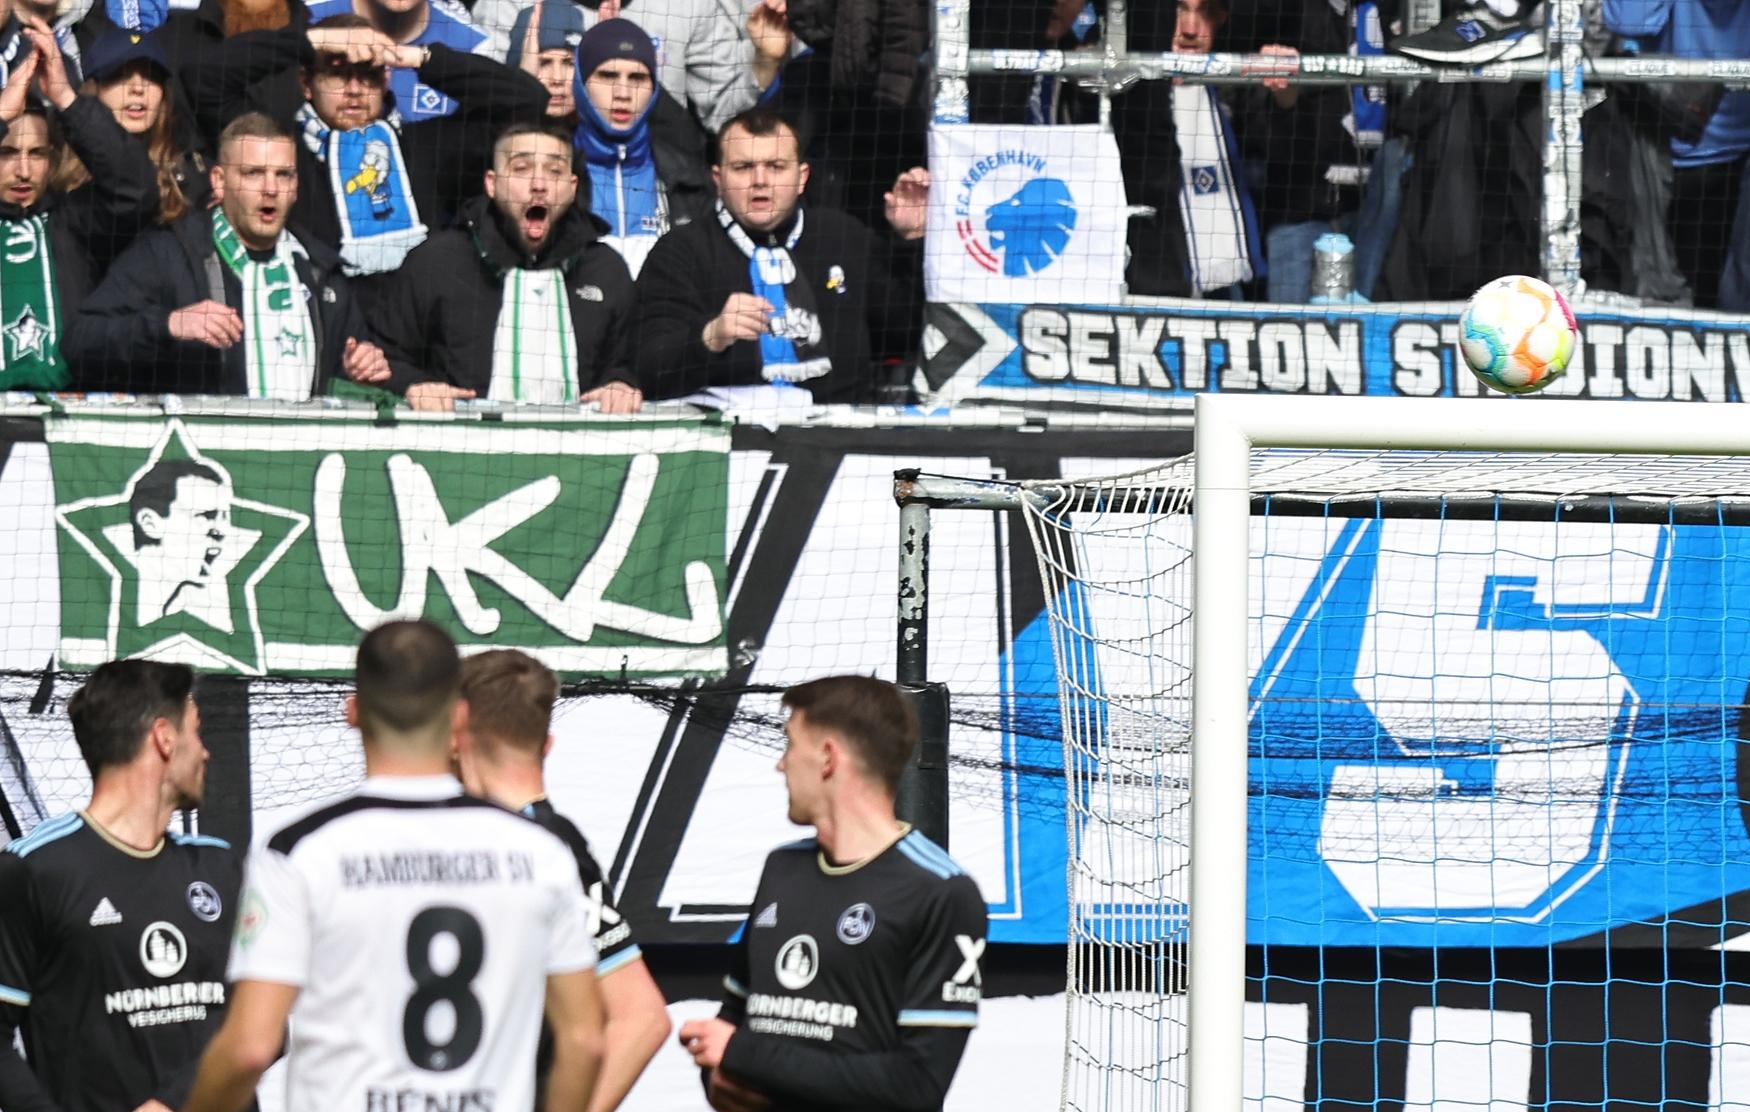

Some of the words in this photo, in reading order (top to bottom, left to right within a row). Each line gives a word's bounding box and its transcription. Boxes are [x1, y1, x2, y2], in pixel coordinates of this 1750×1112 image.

[1021, 308, 1362, 395] SEKTION
[313, 452, 724, 645] UKL
[105, 981, 225, 1014] NÜRNBERER
[403, 905, 485, 1072] 8
